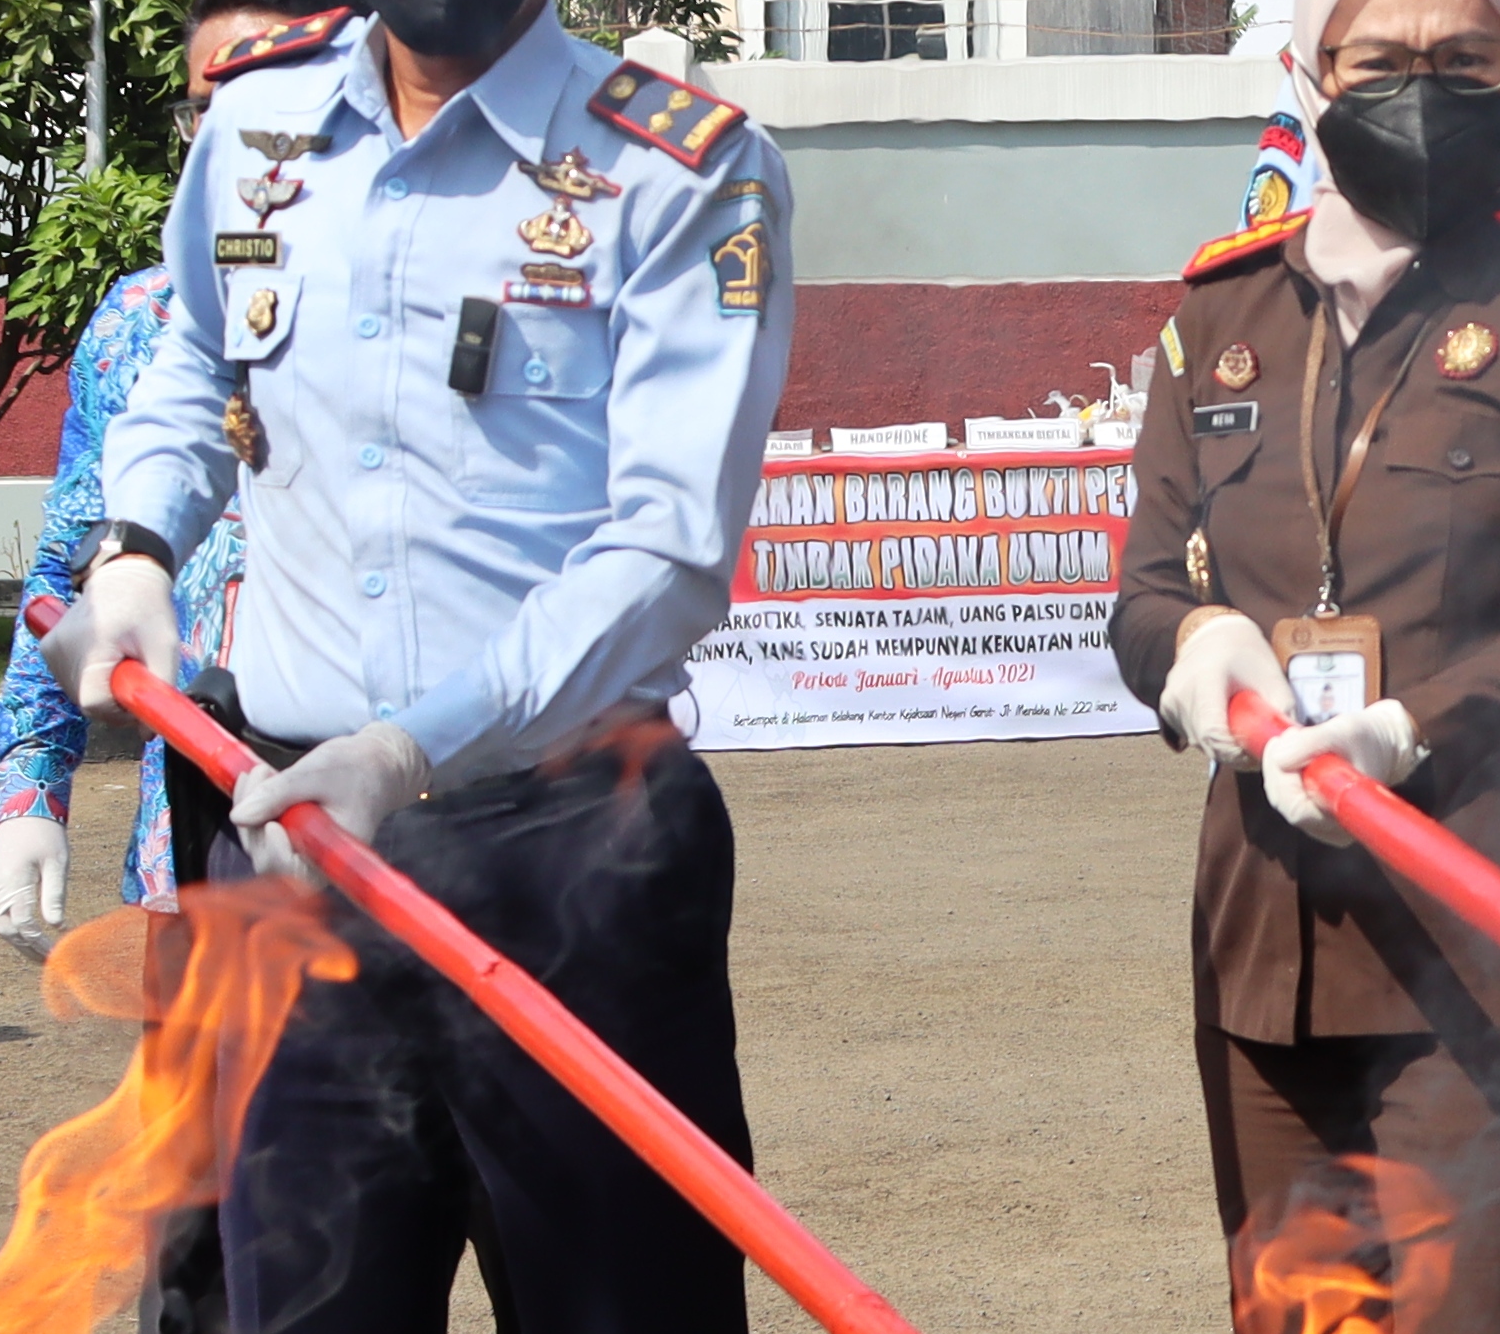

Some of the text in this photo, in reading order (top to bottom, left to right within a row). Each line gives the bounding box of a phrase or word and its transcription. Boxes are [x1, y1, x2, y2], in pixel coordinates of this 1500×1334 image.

[217, 238, 274, 257] CHRISTIO
[769, 441, 804, 452] AJAM
[850, 429, 929, 445] HANDPHONE
[977, 429, 1072, 441] TIMBANGAN DIGITAL
[844, 467, 977, 524] BARANG
[982, 466, 1080, 519] BUKTI
[752, 530, 1110, 593] TINDAK PIDANA UMUM
[715, 601, 1107, 632] ARKOTIKA, SENJATA TAJAM, UANG PALSU DAN
[686, 641, 753, 665] AINNYA,
[757, 640, 807, 662] YANG
[811, 638, 869, 661] SUDAH
[876, 635, 977, 657] MEMPUNYAI
[982, 632, 1073, 655] KEKUATAN
[792, 670, 848, 690] Periode
[855, 668, 919, 692] Januari
[932, 666, 994, 690] Agustus
[998, 663, 1036, 683] 2021
[733, 714, 778, 727] Bertempat
[792, 711, 828, 724] Halaman
[831, 710, 865, 723] Belakang
[868, 708, 896, 721] Kantor
[900, 707, 938, 723] Kejaksaan
[941, 705, 968, 720] Negeri
[1015, 703, 1050, 716] Merdeka
[1071, 700, 1093, 715] 222
